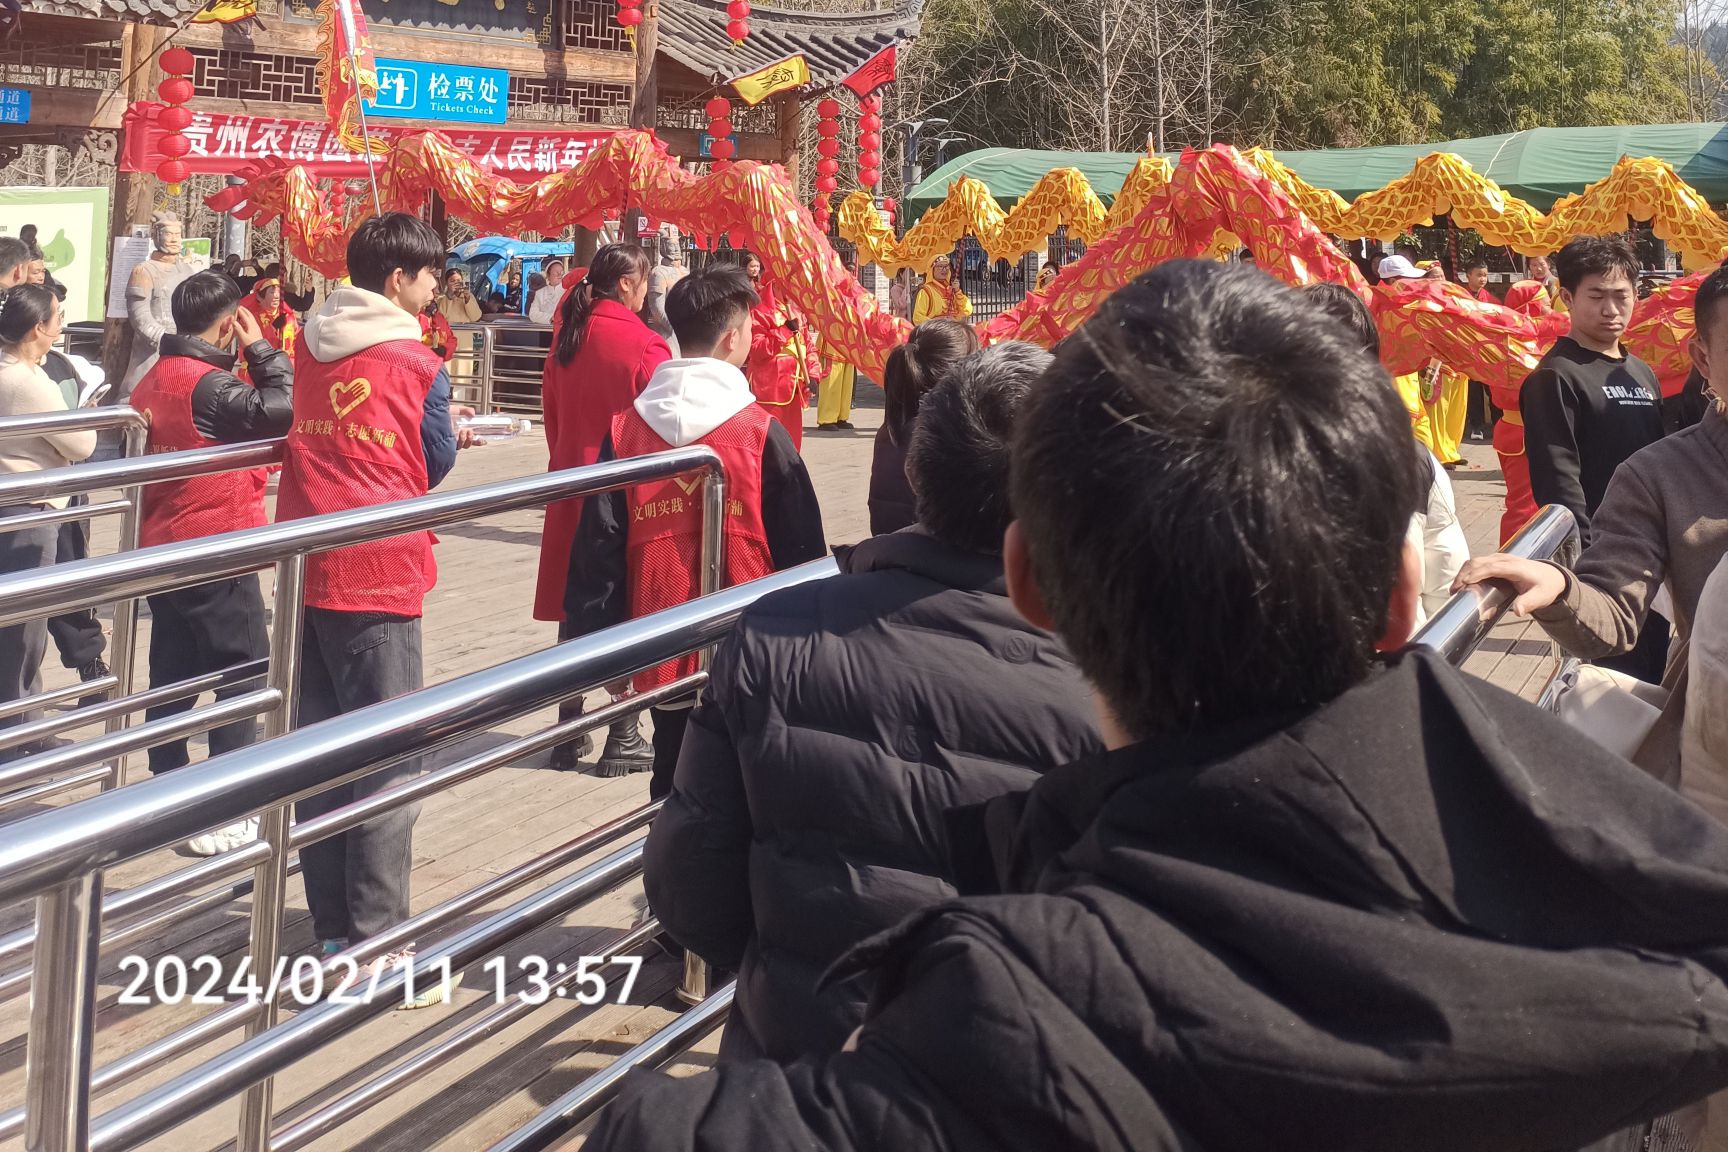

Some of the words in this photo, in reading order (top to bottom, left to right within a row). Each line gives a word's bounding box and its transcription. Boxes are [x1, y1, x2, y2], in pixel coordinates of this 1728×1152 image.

[428, 72, 498, 103] 检票处
[430, 102, 464, 113] Tickets
[466, 106, 494, 115] Check
